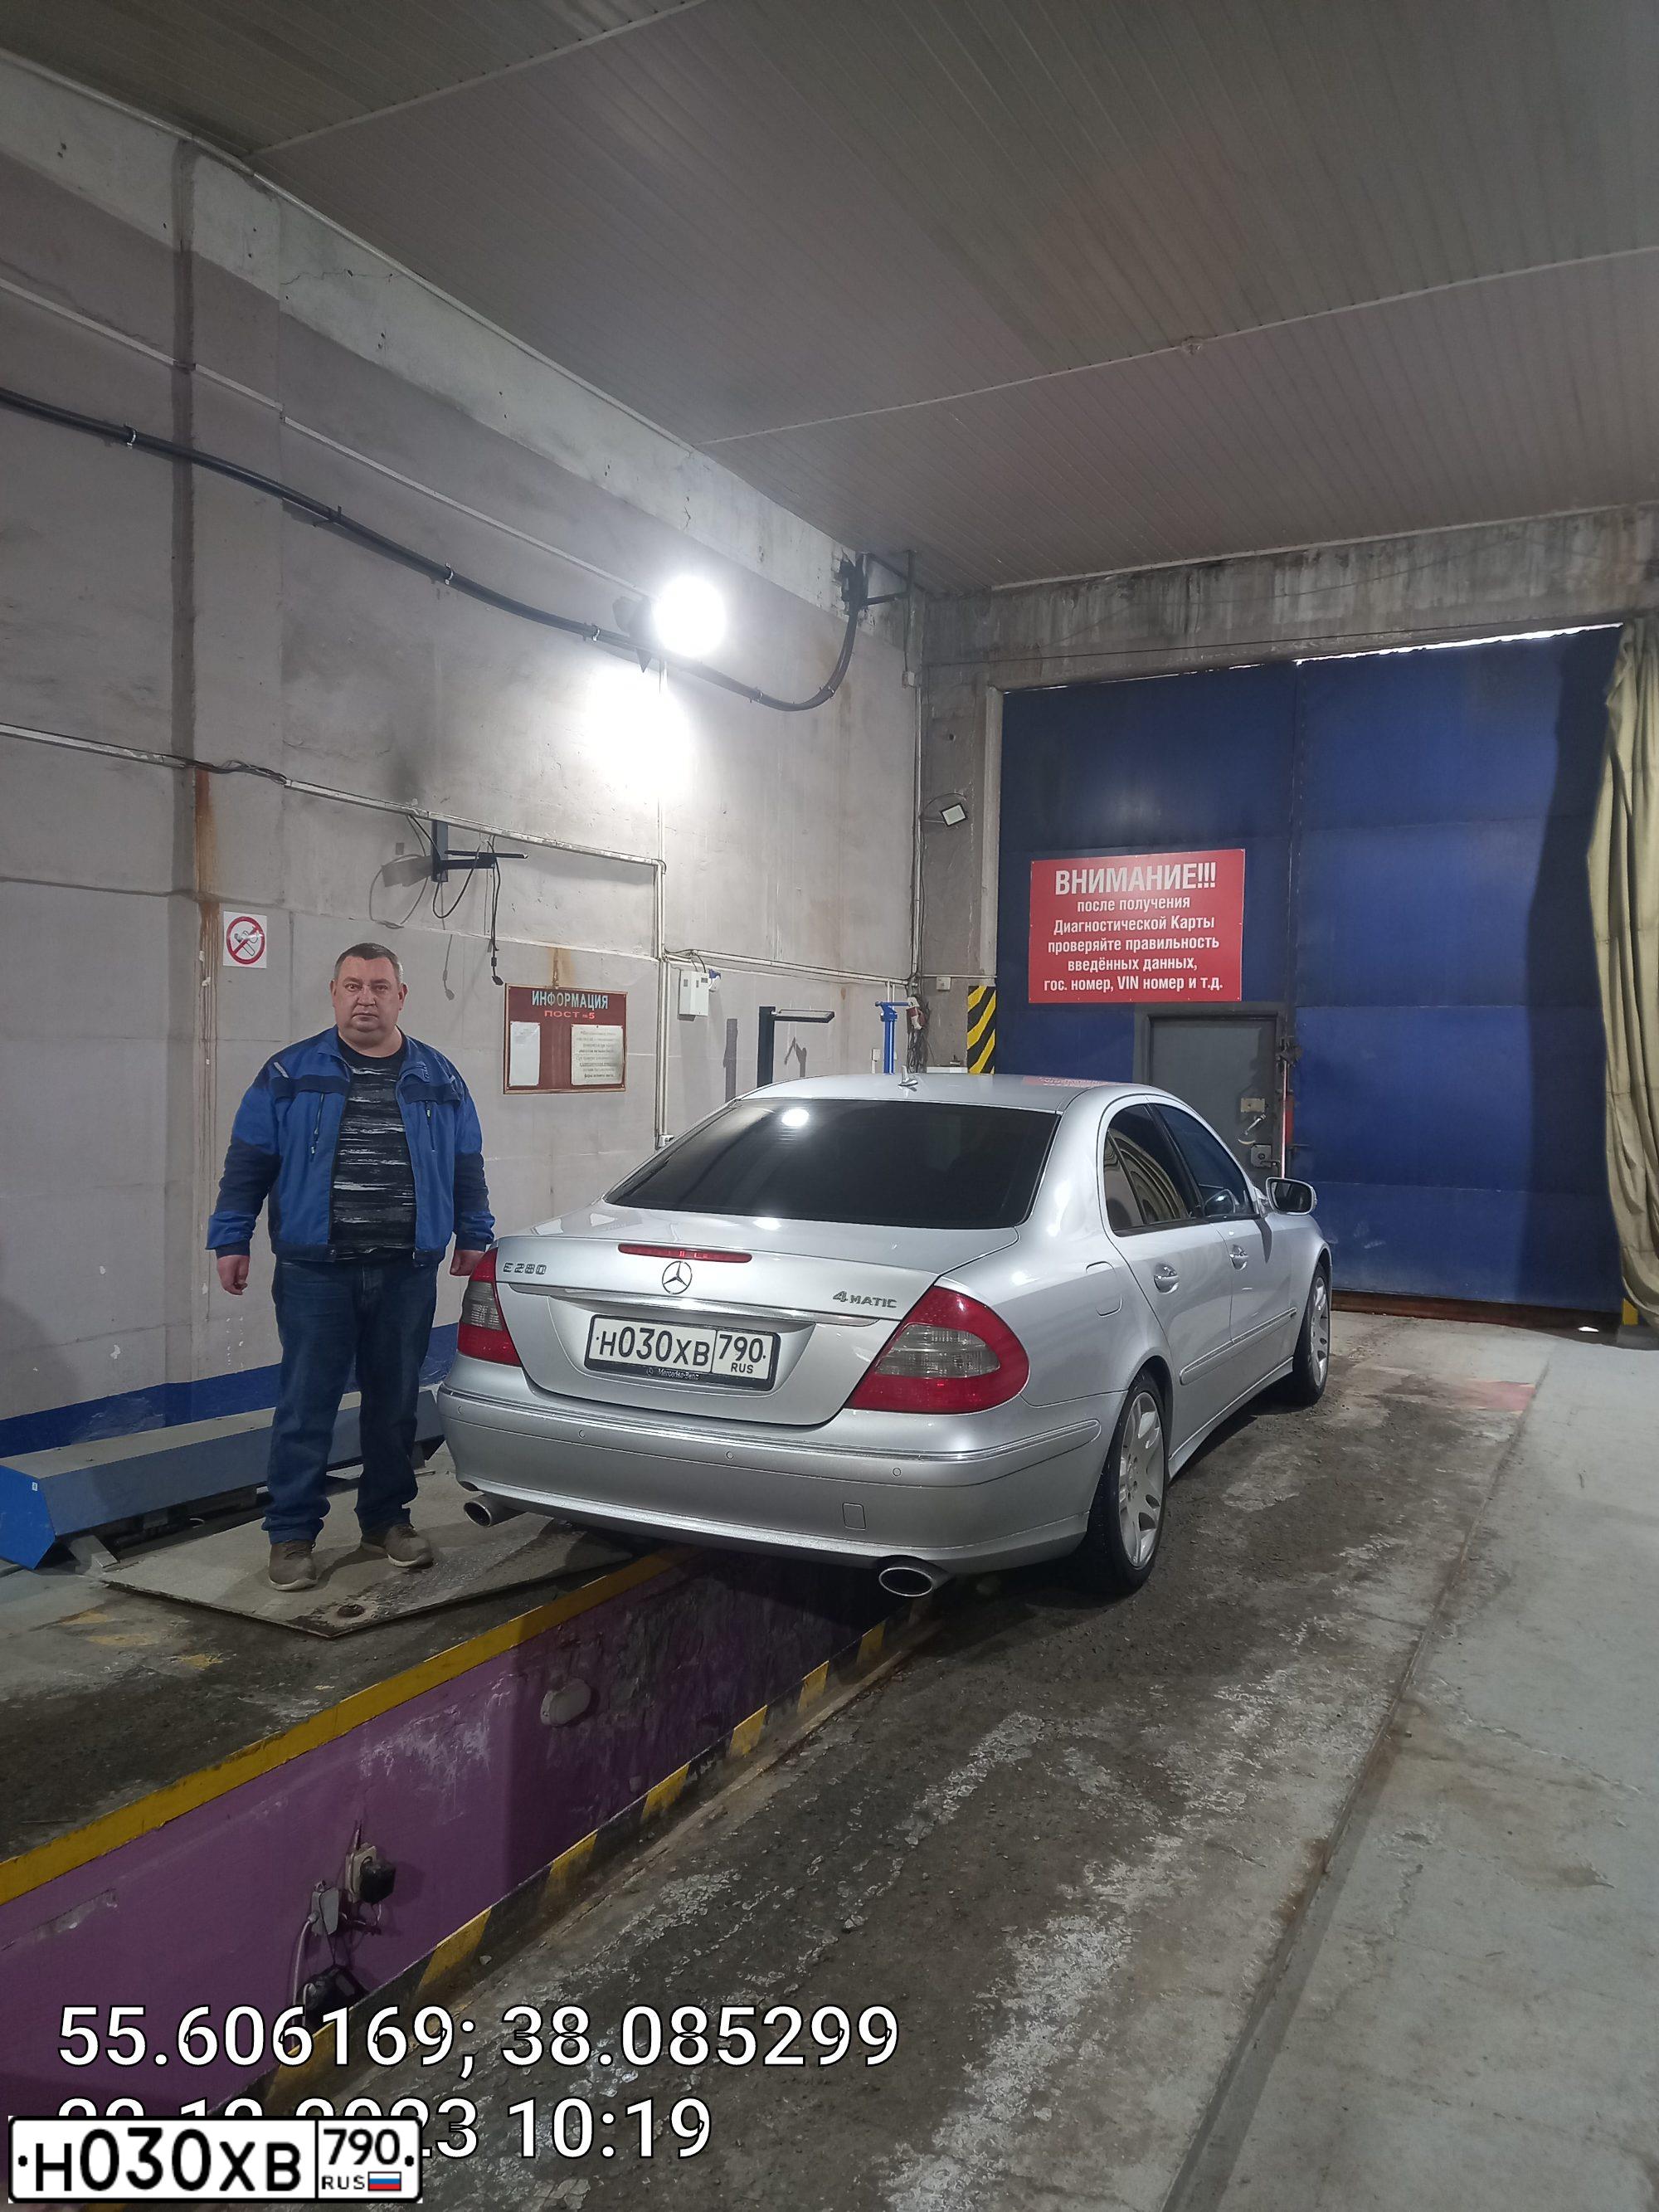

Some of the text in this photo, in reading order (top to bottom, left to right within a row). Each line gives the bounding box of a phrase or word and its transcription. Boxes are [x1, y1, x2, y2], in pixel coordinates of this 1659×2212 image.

[1055, 861, 1216, 895] ВНИМАНИЕ!!!
[1077, 896, 1190, 913] после получения
[1053, 916, 1215, 936] Диагностической Карты
[1048, 936, 1219, 956] проверяйте правильность
[1068, 956, 1198, 973] введённых данных,
[1044, 975, 1224, 992] гос. номер, VIN номер и т.д.
[532, 990, 609, 1011] ИНФОРМАЦИЯ
[544, 1010, 580, 1018] ПОСТ
[730, 1362, 754, 1374] RUS
